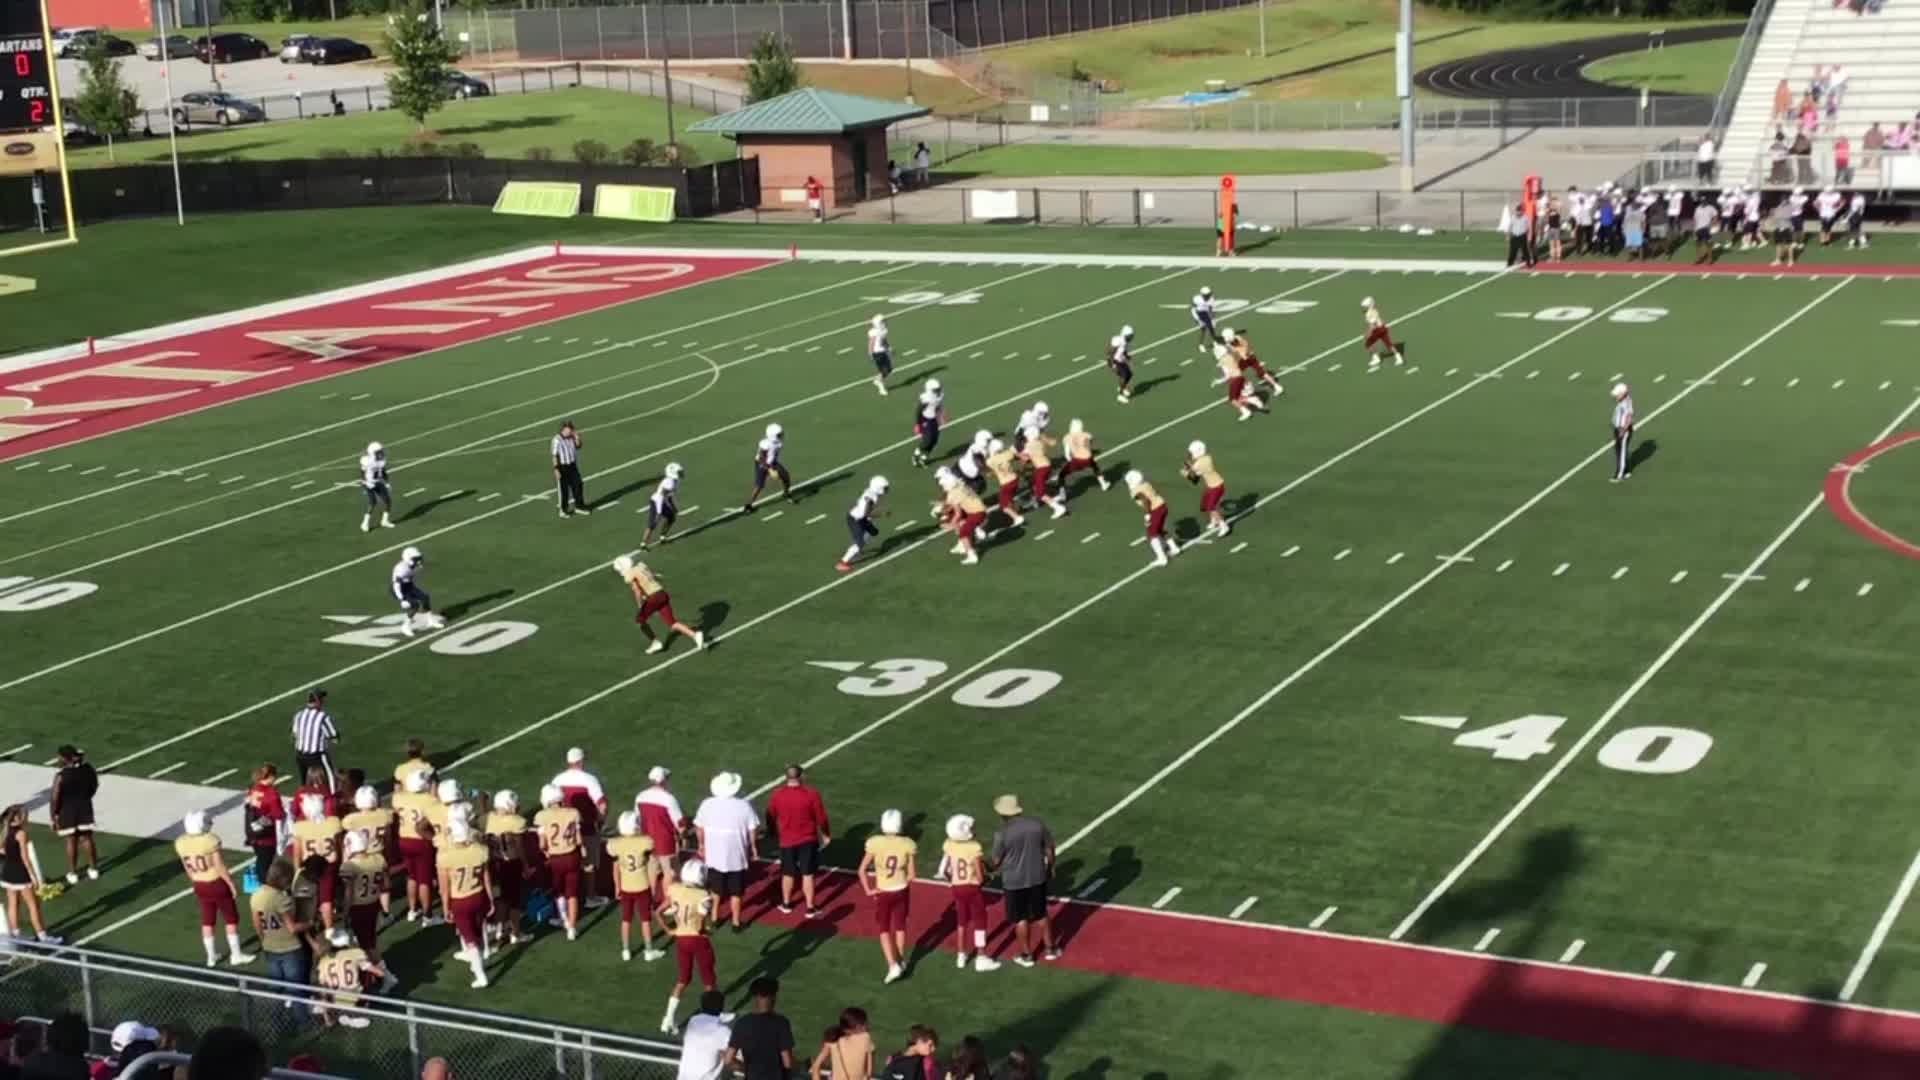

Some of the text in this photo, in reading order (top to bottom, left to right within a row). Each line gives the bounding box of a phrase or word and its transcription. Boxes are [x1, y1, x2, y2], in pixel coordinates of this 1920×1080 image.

[15, 53, 29, 75] 0
[31, 100, 43, 122] 2
[321, 611, 540, 655] 20
[836, 658, 1064, 708] 30
[1453, 714, 1714, 774] 40
[886, 855, 898, 878] 9
